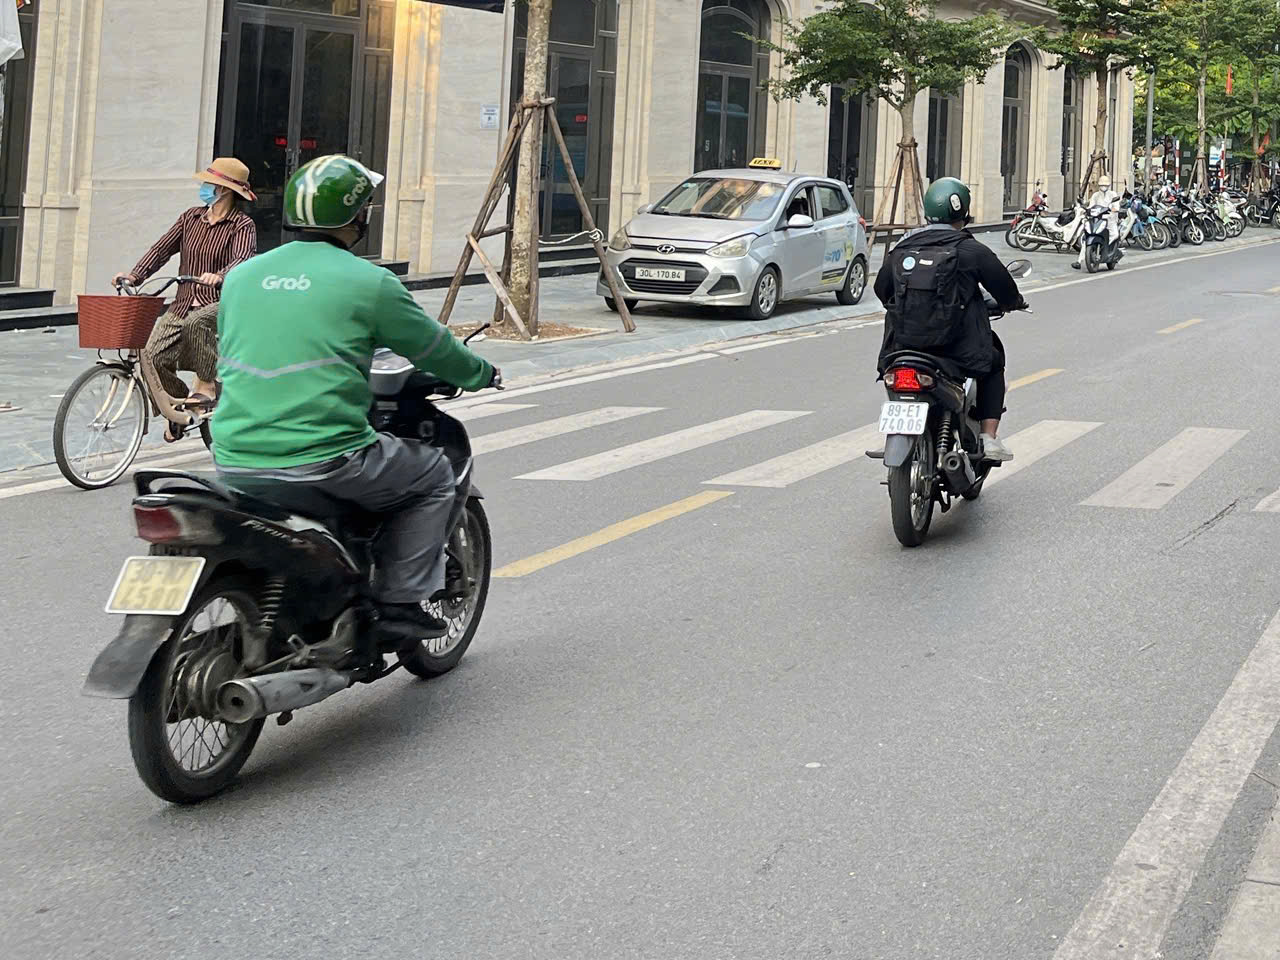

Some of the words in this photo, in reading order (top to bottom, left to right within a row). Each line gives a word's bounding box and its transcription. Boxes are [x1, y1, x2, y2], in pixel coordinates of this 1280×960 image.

[343, 176, 368, 207] Grab
[261, 273, 311, 291] Grab
[888, 404, 921, 418] 89-E1
